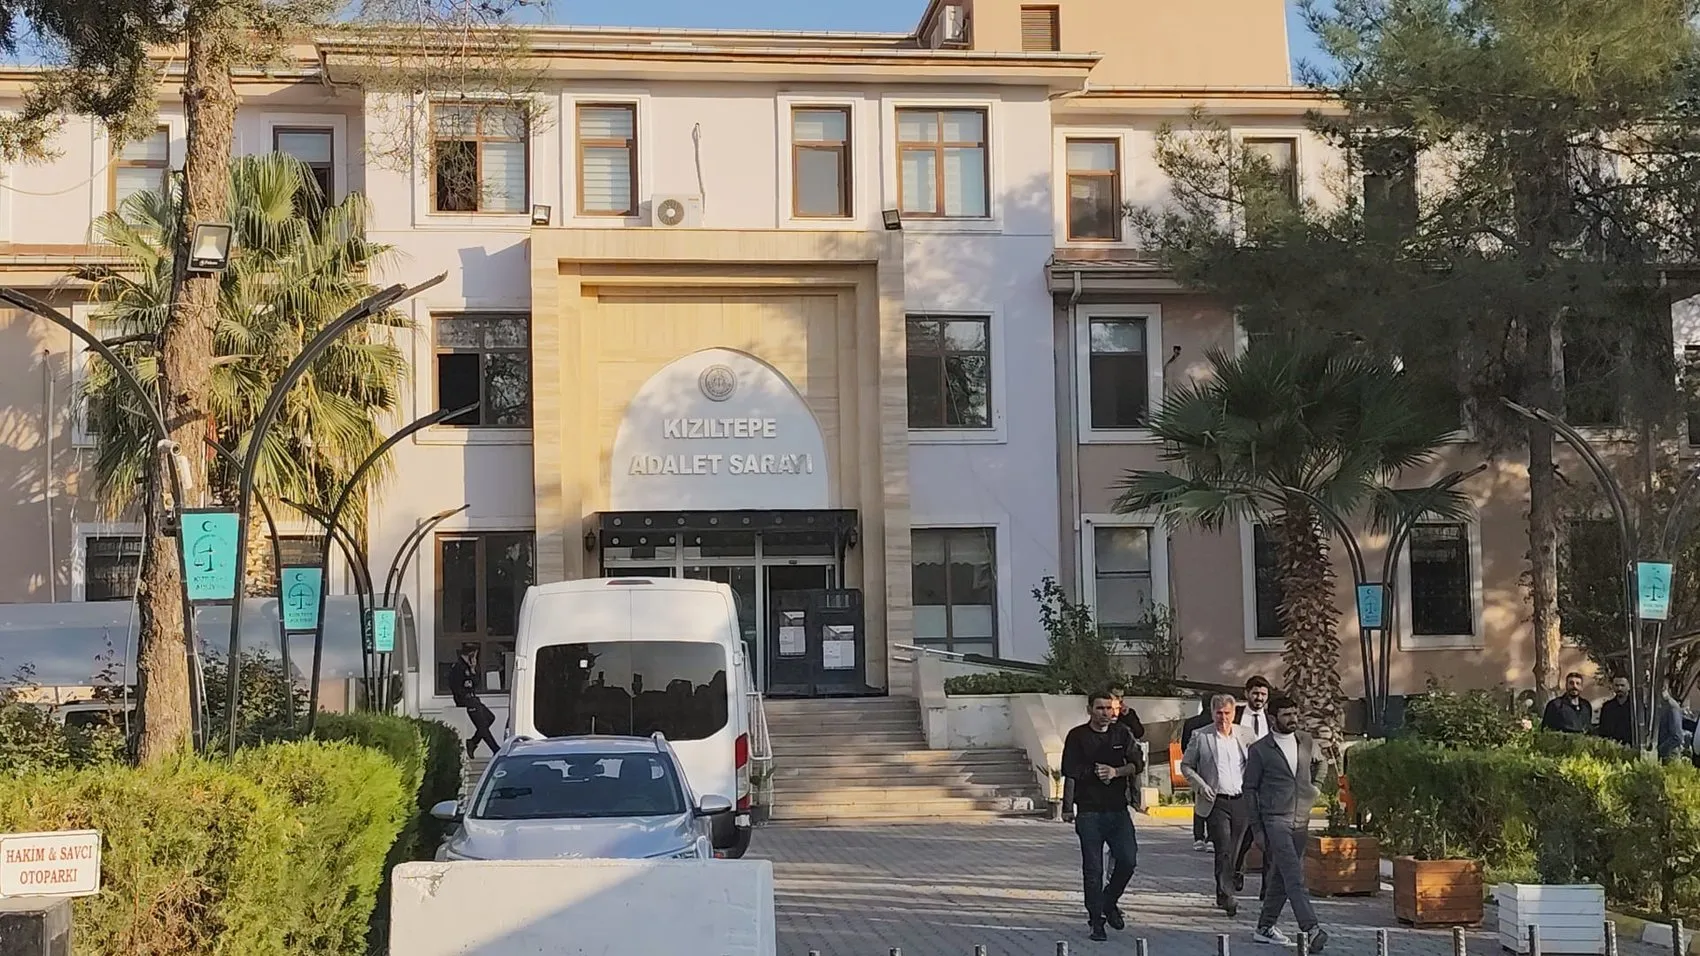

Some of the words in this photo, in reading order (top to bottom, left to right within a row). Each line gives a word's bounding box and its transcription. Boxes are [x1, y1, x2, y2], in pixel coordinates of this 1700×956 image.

[663, 417, 777, 439] KIZILTEPE
[629, 453, 723, 475] ADALET
[729, 453, 813, 475] SARAYI
[6, 845, 45, 863] HAKİM
[48, 847, 57, 861] &
[60, 845, 93, 860] SAVCI
[19, 869, 77, 885] OTOPARKI
